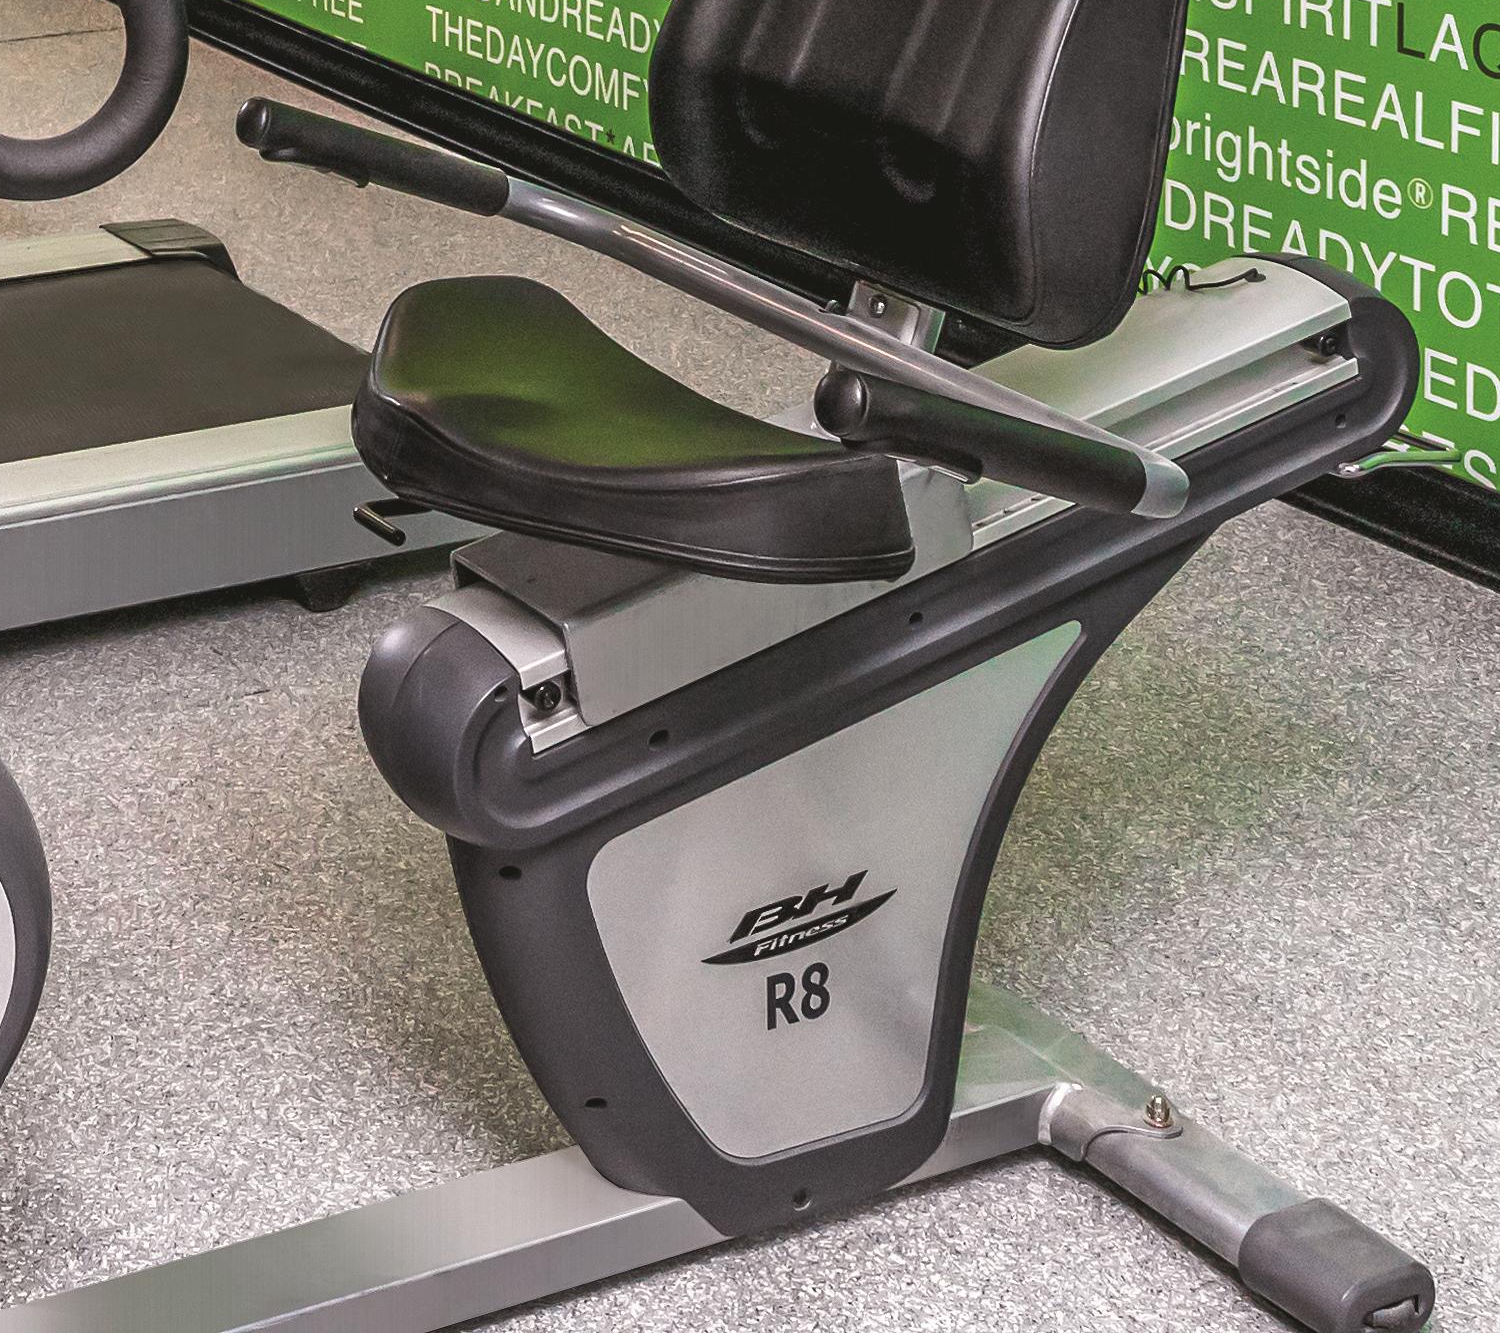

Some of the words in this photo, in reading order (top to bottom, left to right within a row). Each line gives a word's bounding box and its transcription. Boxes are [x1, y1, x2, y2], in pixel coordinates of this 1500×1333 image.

[426, 5, 648, 110] THEDAYCOMF
[728, 869, 869, 944] BH
[753, 914, 850, 957] Fitness
[766, 962, 831, 1031] R8
